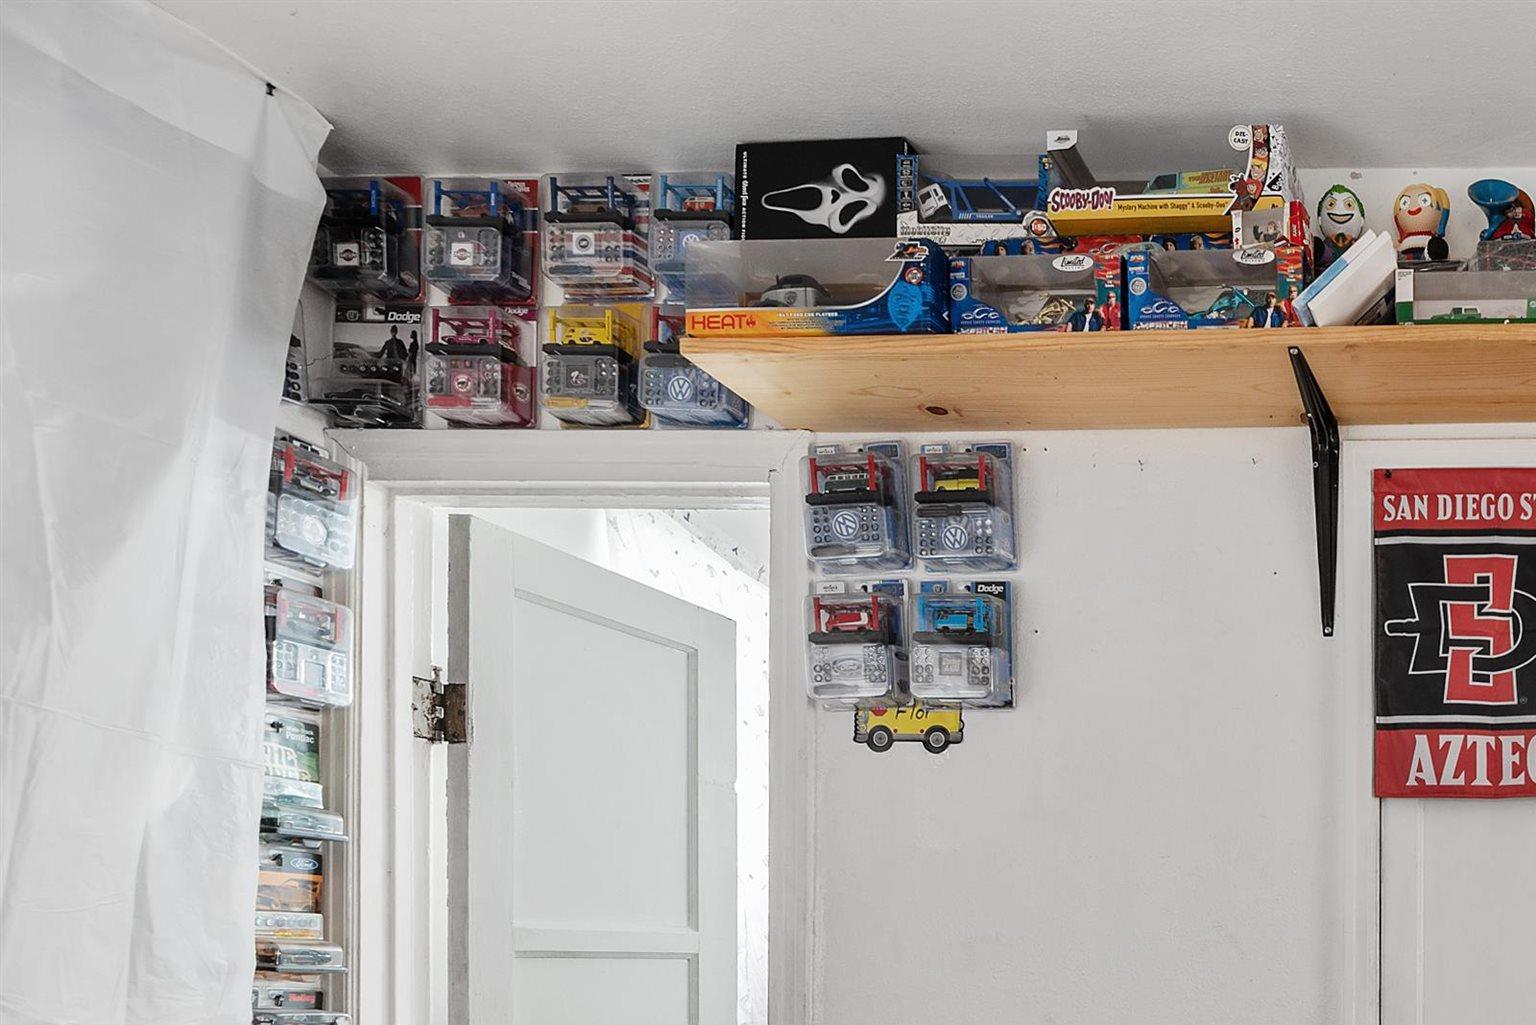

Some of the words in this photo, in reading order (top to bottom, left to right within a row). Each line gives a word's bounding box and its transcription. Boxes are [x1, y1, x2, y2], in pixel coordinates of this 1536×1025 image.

[1050, 189, 1114, 213] SCOOBY-DOO!
[387, 311, 421, 323] Dodge
[691, 314, 747, 330] HEAT
[1383, 494, 1429, 522] SAN
[1437, 493, 1514, 521] DIEGO
[977, 584, 1004, 594] Dodge
